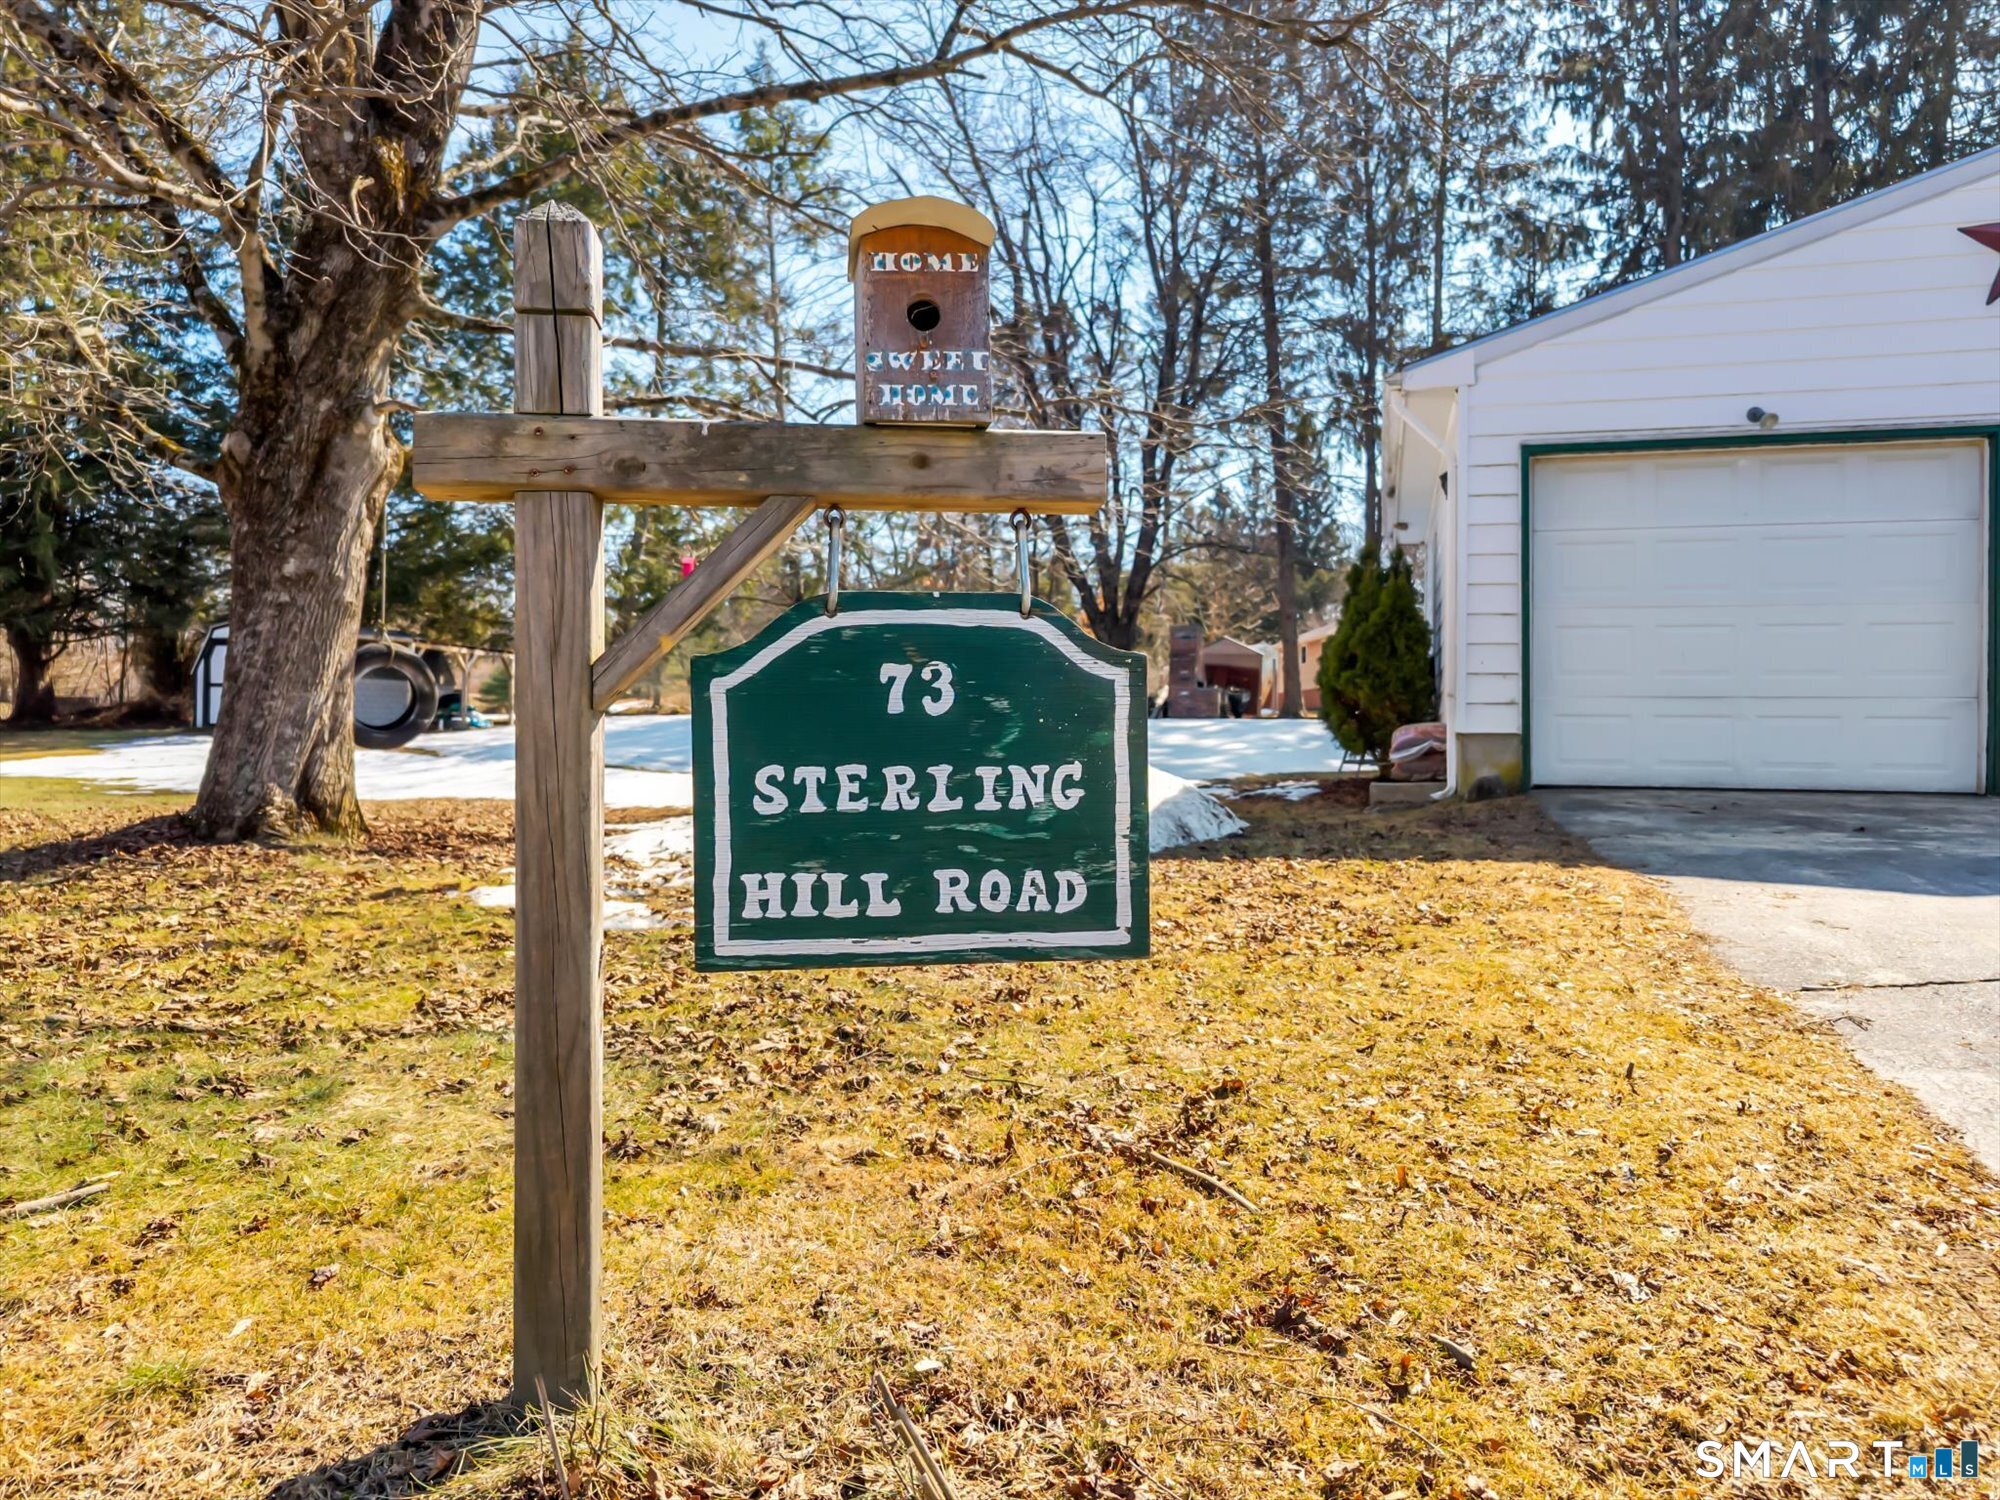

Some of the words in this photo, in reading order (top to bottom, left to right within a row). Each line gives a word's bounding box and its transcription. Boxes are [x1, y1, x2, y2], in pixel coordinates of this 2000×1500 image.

[870, 252, 979, 272] HOME
[866, 351, 989, 371] SWEET
[878, 384, 979, 406] HOME
[880, 660, 955, 716] 73
[752, 761, 1086, 815] STERLING
[740, 872, 901, 919] HILL
[933, 869, 1088, 913] ROAD
